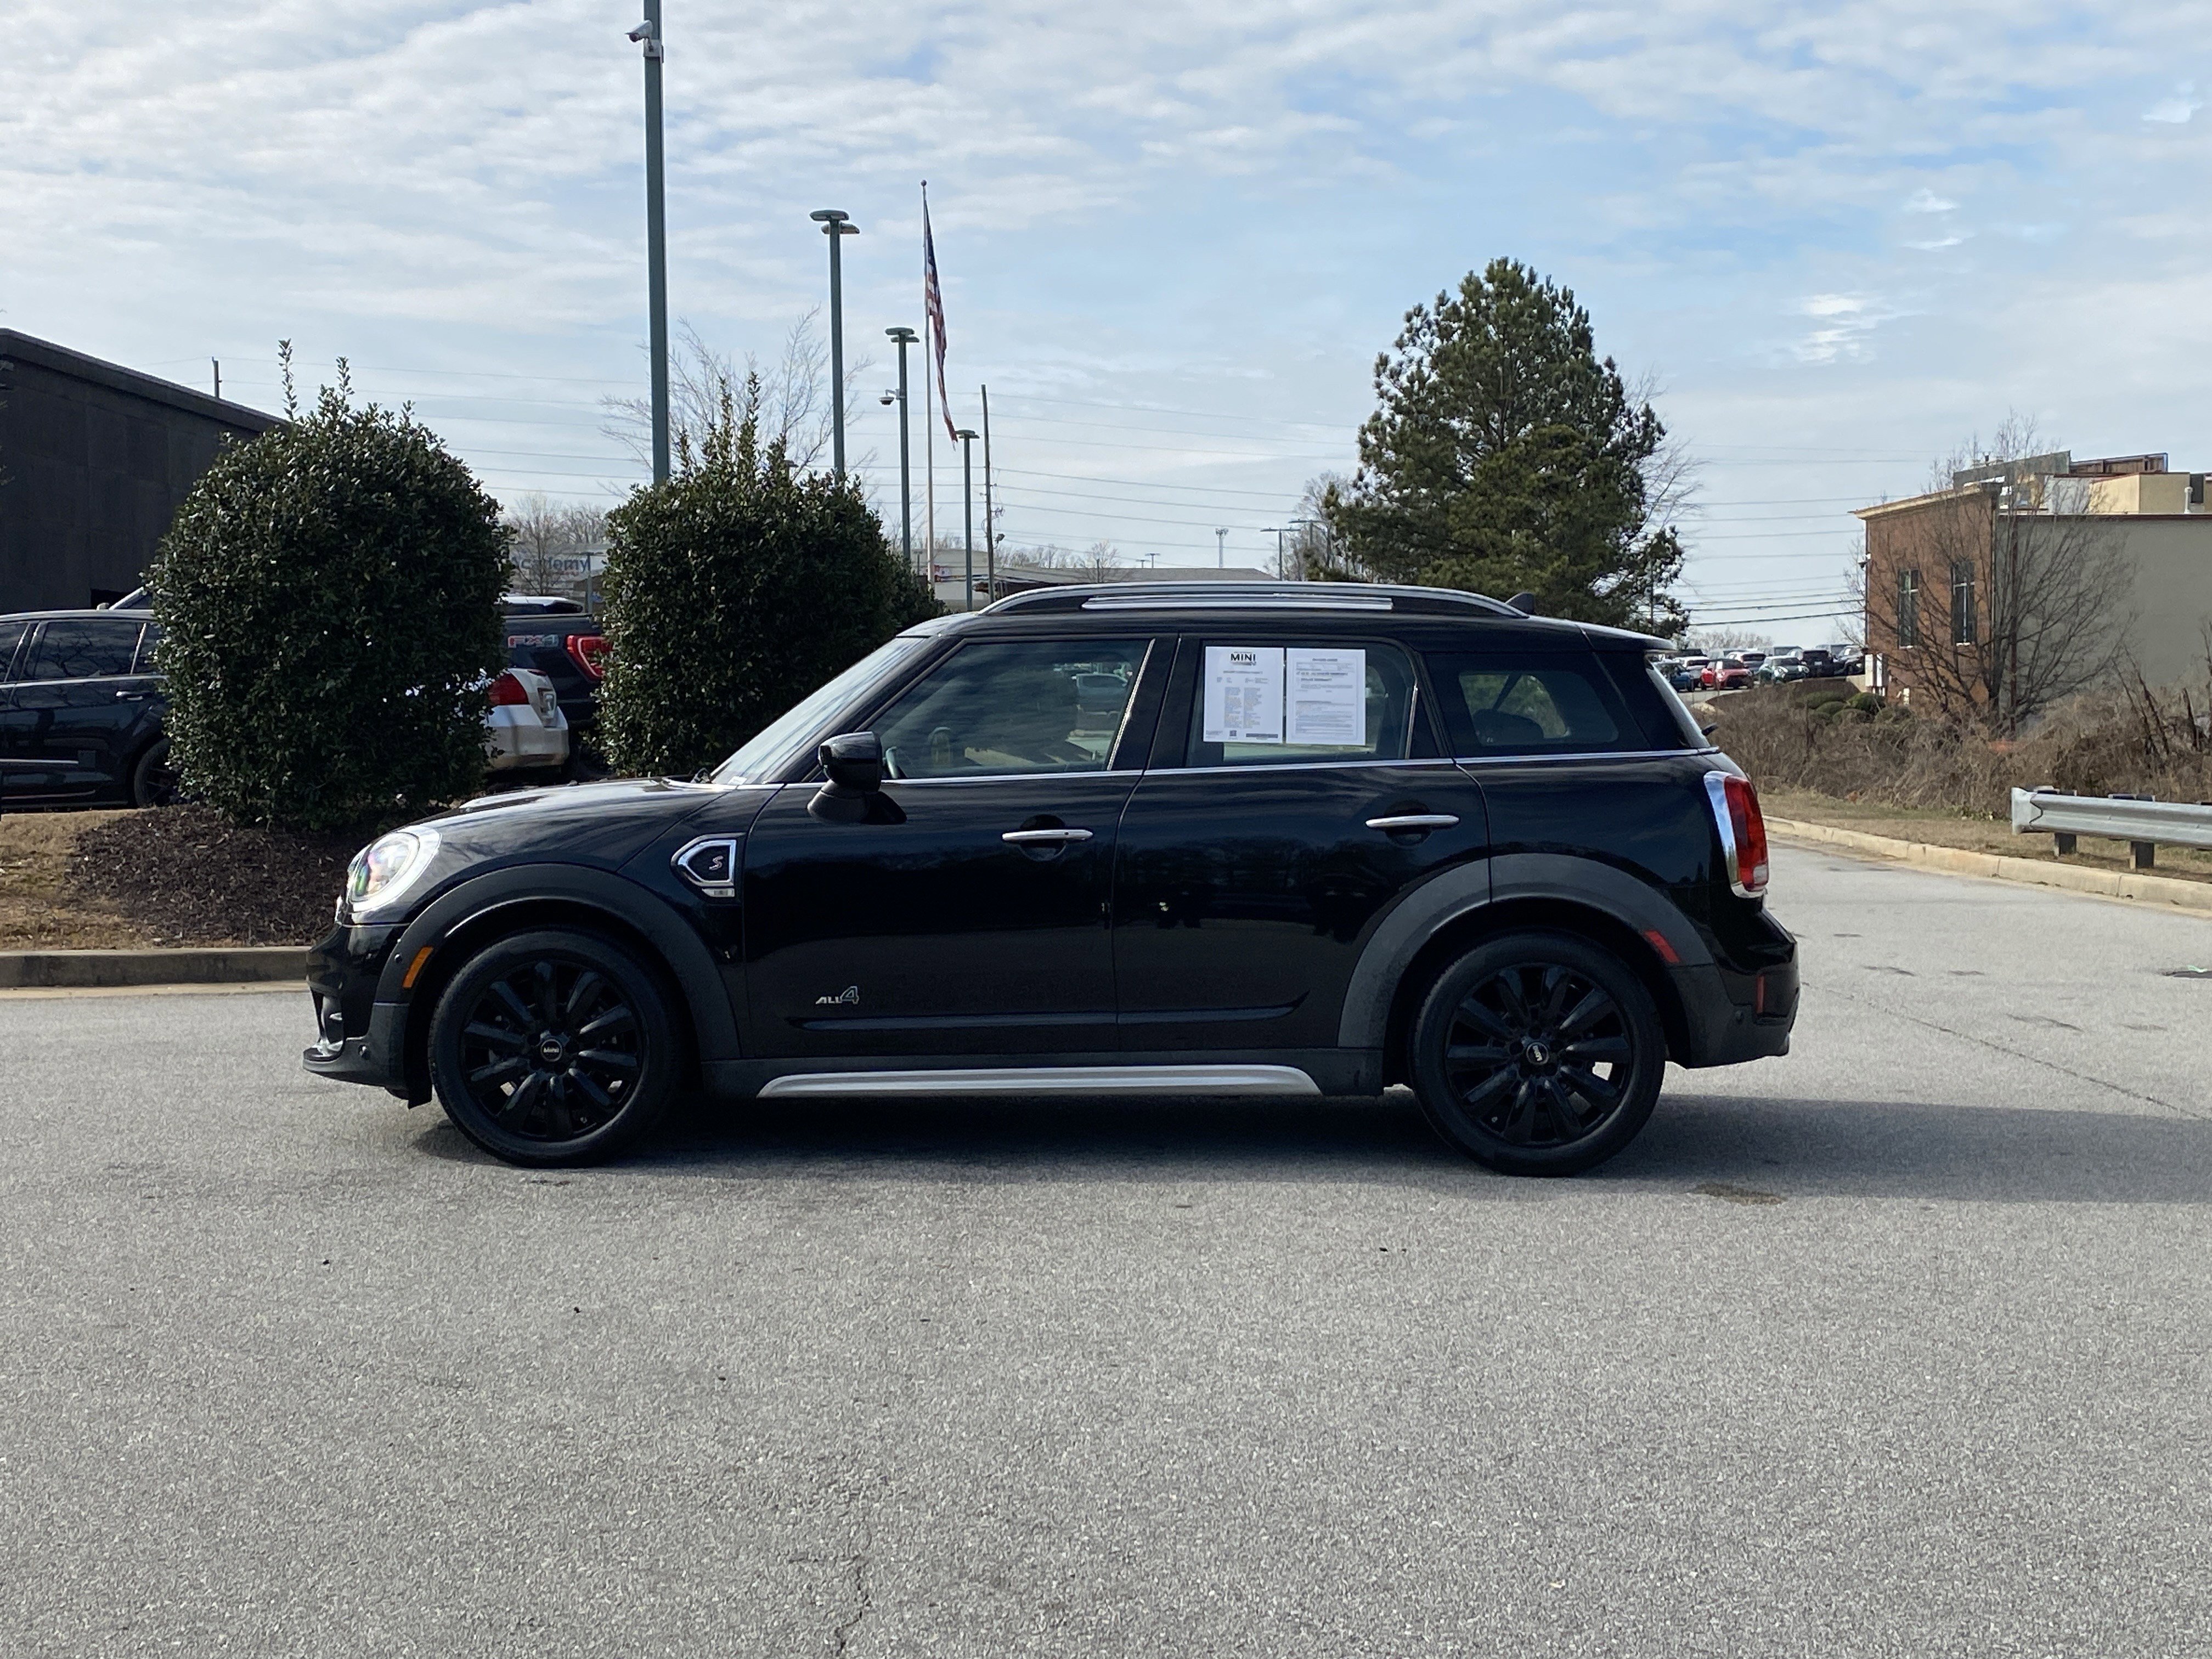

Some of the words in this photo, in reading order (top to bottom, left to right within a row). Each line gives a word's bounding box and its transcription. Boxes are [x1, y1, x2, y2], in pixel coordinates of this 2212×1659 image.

[507, 634, 559, 648] FX4
[1231, 653, 1256, 662] MINI
[709, 855, 724, 871] S
[815, 986, 859, 1005] ALL4
